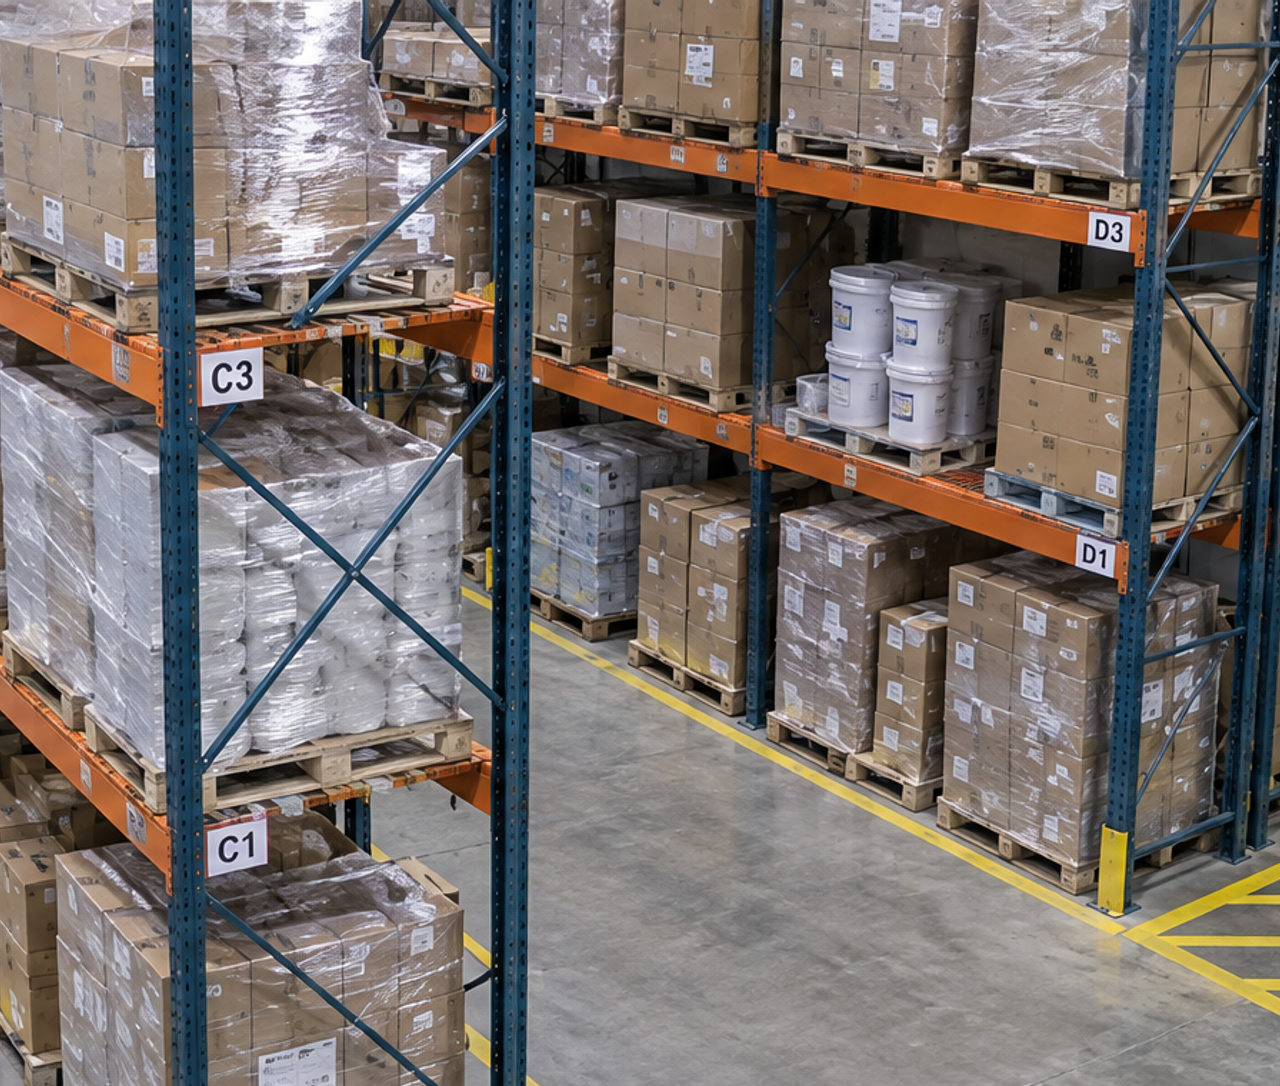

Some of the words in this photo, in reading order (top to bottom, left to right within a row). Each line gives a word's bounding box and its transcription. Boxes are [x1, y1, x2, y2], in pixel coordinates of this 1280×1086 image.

[1094, 217, 1124, 244] D3
[210, 359, 254, 394] C3
[1081, 542, 1108, 570] D1
[217, 830, 257, 864] C1
